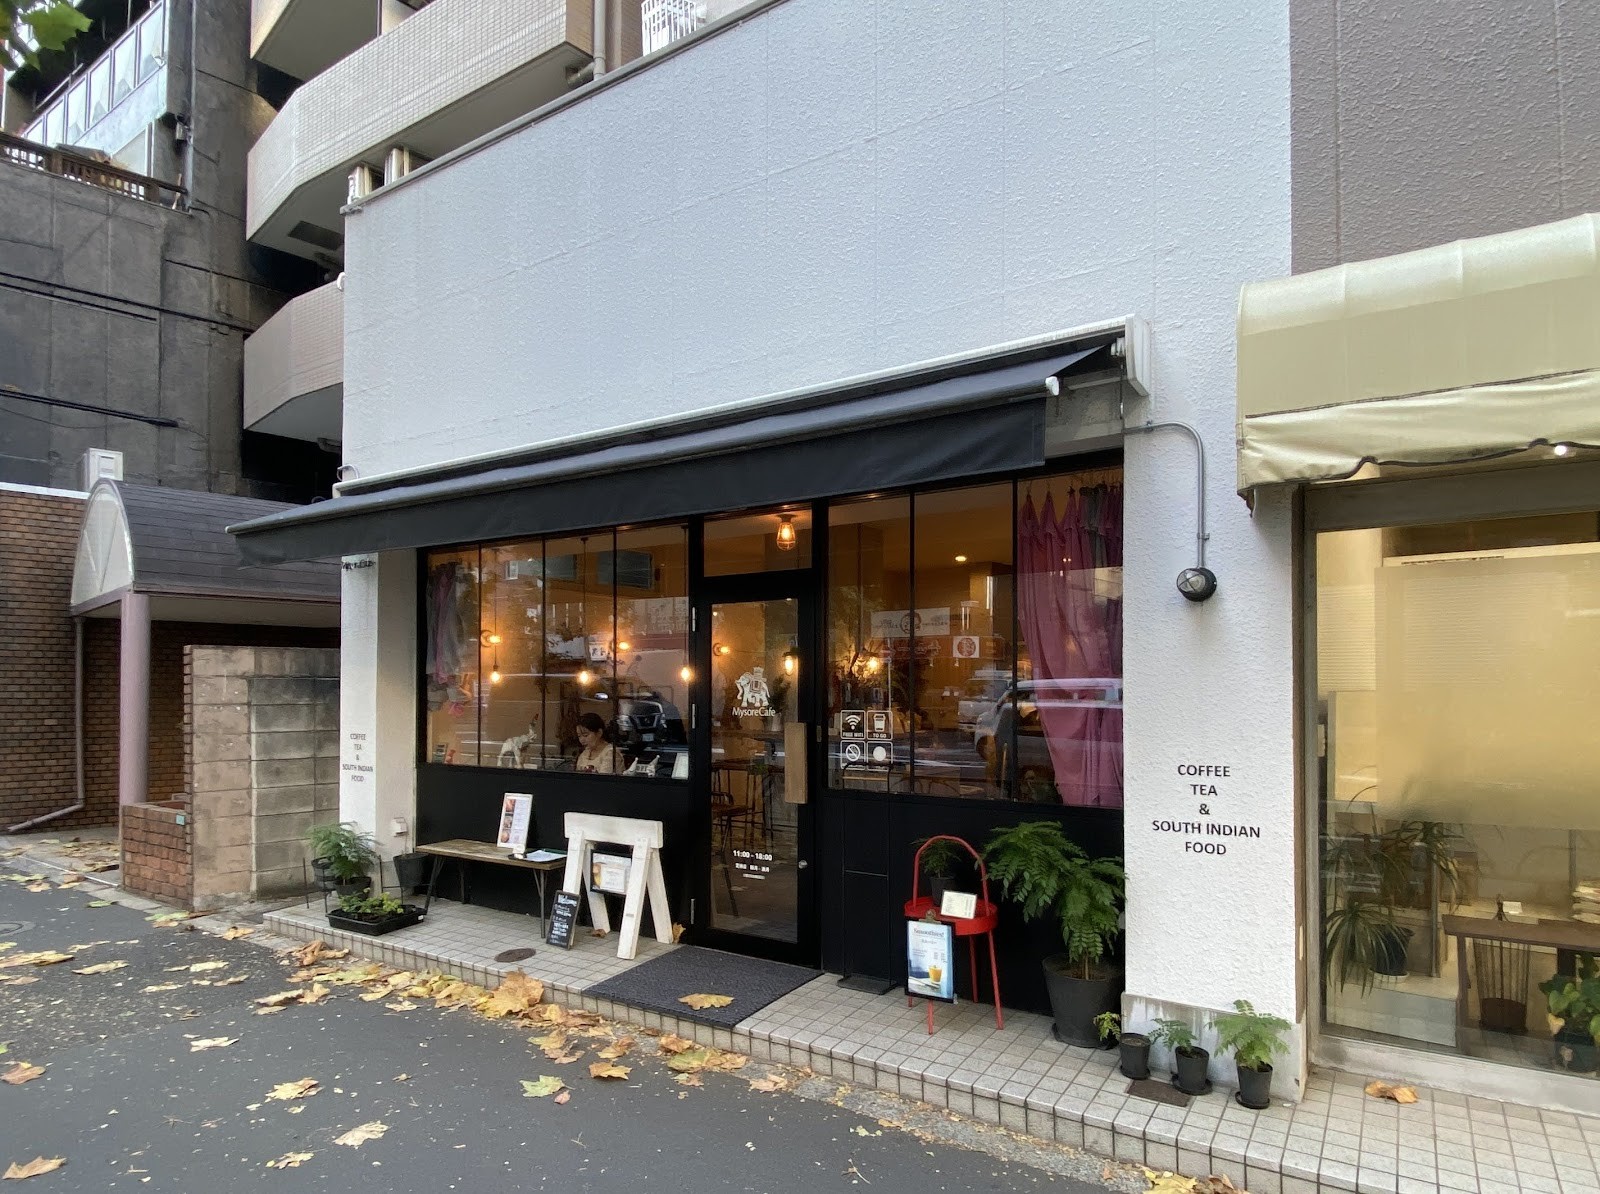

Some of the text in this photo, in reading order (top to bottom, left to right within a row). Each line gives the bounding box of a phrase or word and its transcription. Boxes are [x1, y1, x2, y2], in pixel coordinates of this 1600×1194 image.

[350, 733, 366, 741] COFFEE
[342, 763, 357, 771] SOUTH
[1177, 764, 1231, 777] COFFEE
[351, 774, 364, 782] FOOD
[1190, 784, 1218, 796] TEA
[1199, 803, 1210, 815] &
[1152, 820, 1260, 838] SOUTH INDIAN
[1185, 841, 1227, 855] FOOD
[733, 850, 750, 858] 11:00
[755, 852, 773, 861] 18:00
